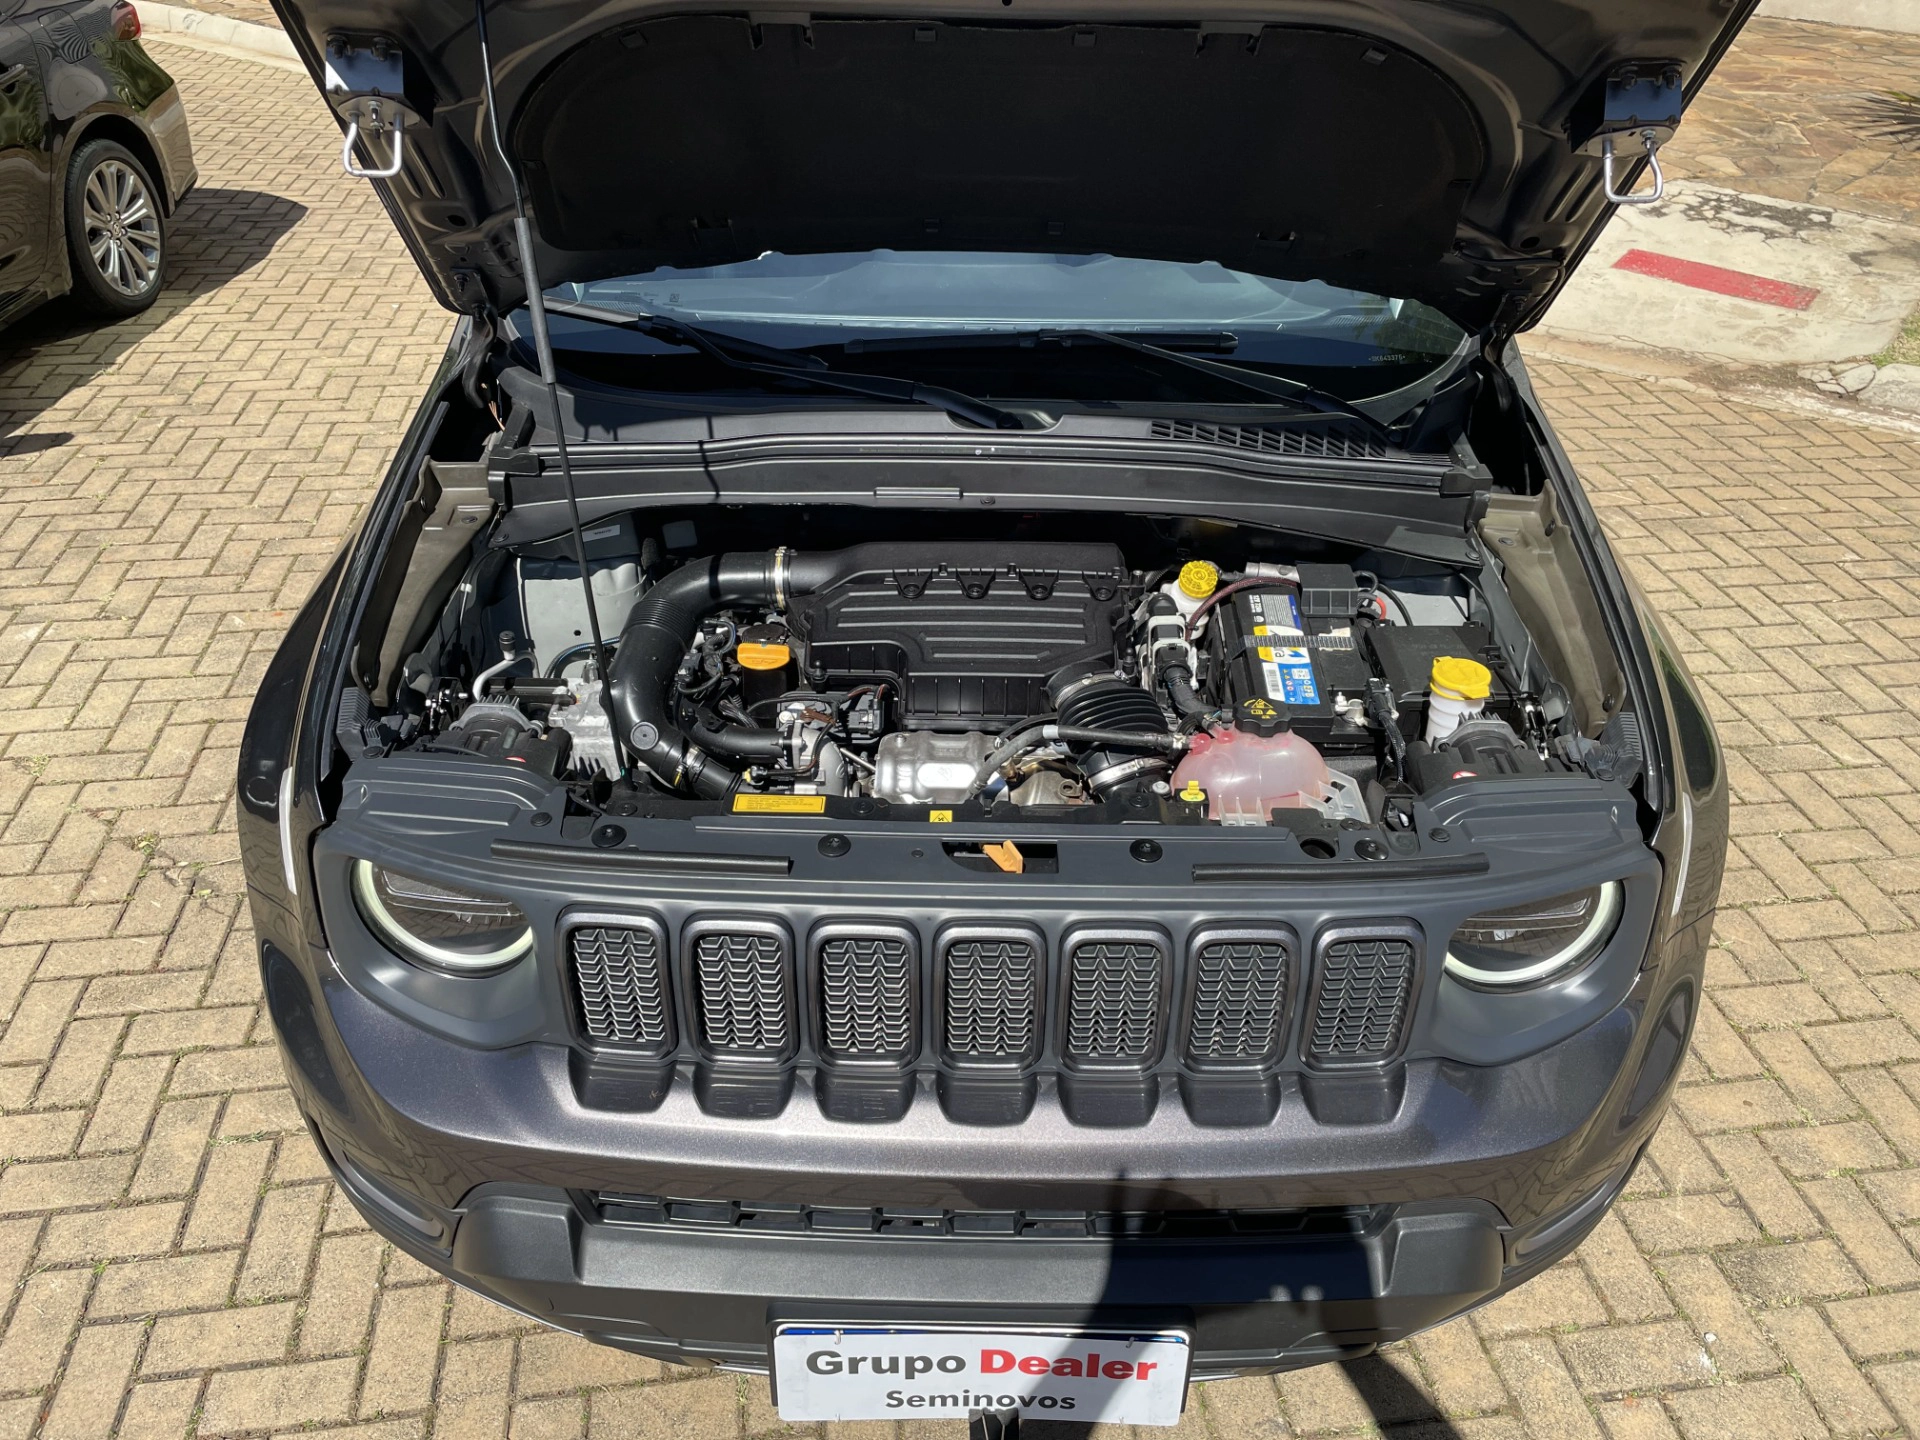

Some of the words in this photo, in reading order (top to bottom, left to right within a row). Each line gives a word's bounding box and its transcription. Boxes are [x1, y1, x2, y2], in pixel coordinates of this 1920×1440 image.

[806, 1350, 966, 1380] Grupo
[980, 1349, 1158, 1381] Dealer
[885, 1389, 1076, 1410] Seminovos
